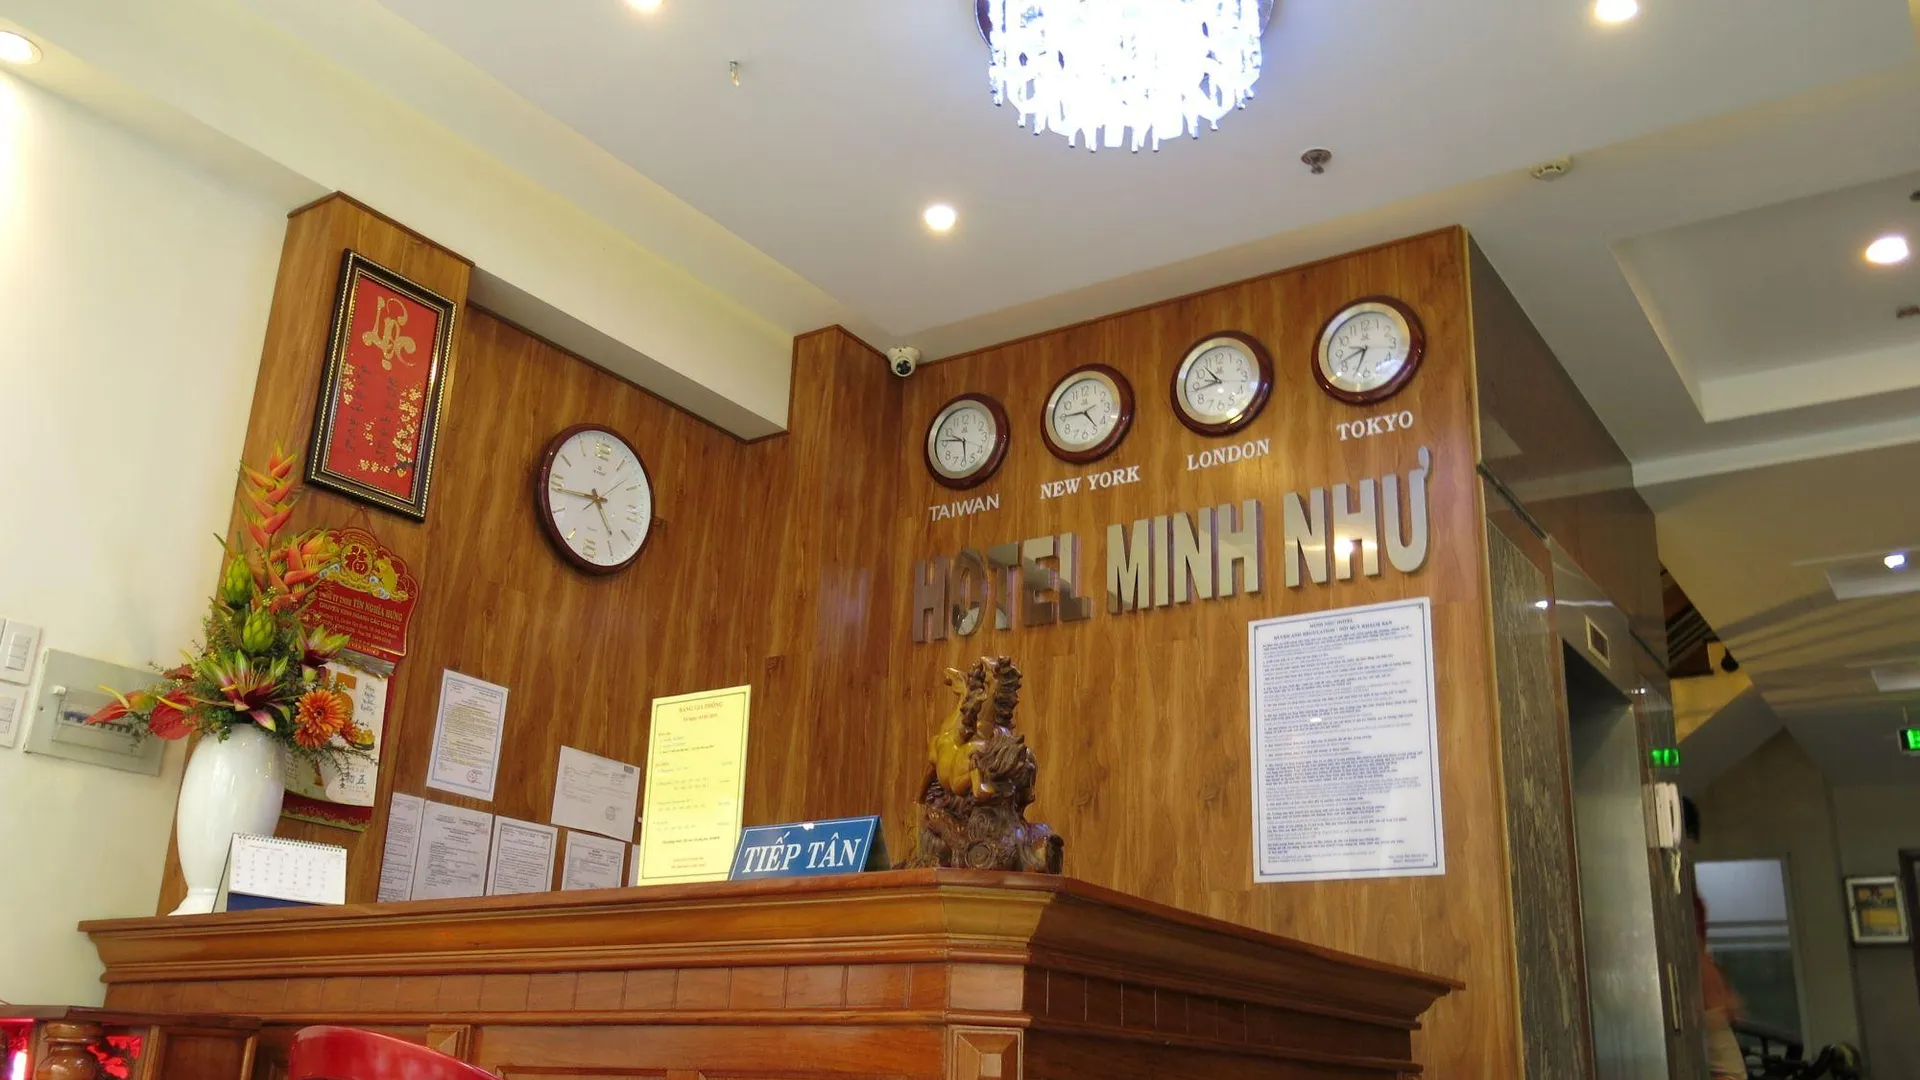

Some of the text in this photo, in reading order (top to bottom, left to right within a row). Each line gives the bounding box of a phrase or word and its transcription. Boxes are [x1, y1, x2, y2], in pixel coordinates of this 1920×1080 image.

[1336, 411, 1415, 441] TOKYO
[1186, 439, 1271, 471] LONDON
[1039, 465, 1140, 501] NEW YORK
[929, 494, 1000, 522] TAIWAN
[913, 445, 1432, 643] HOTEL MINH NHƯ
[742, 831, 861, 873] TIẾP TÂN
